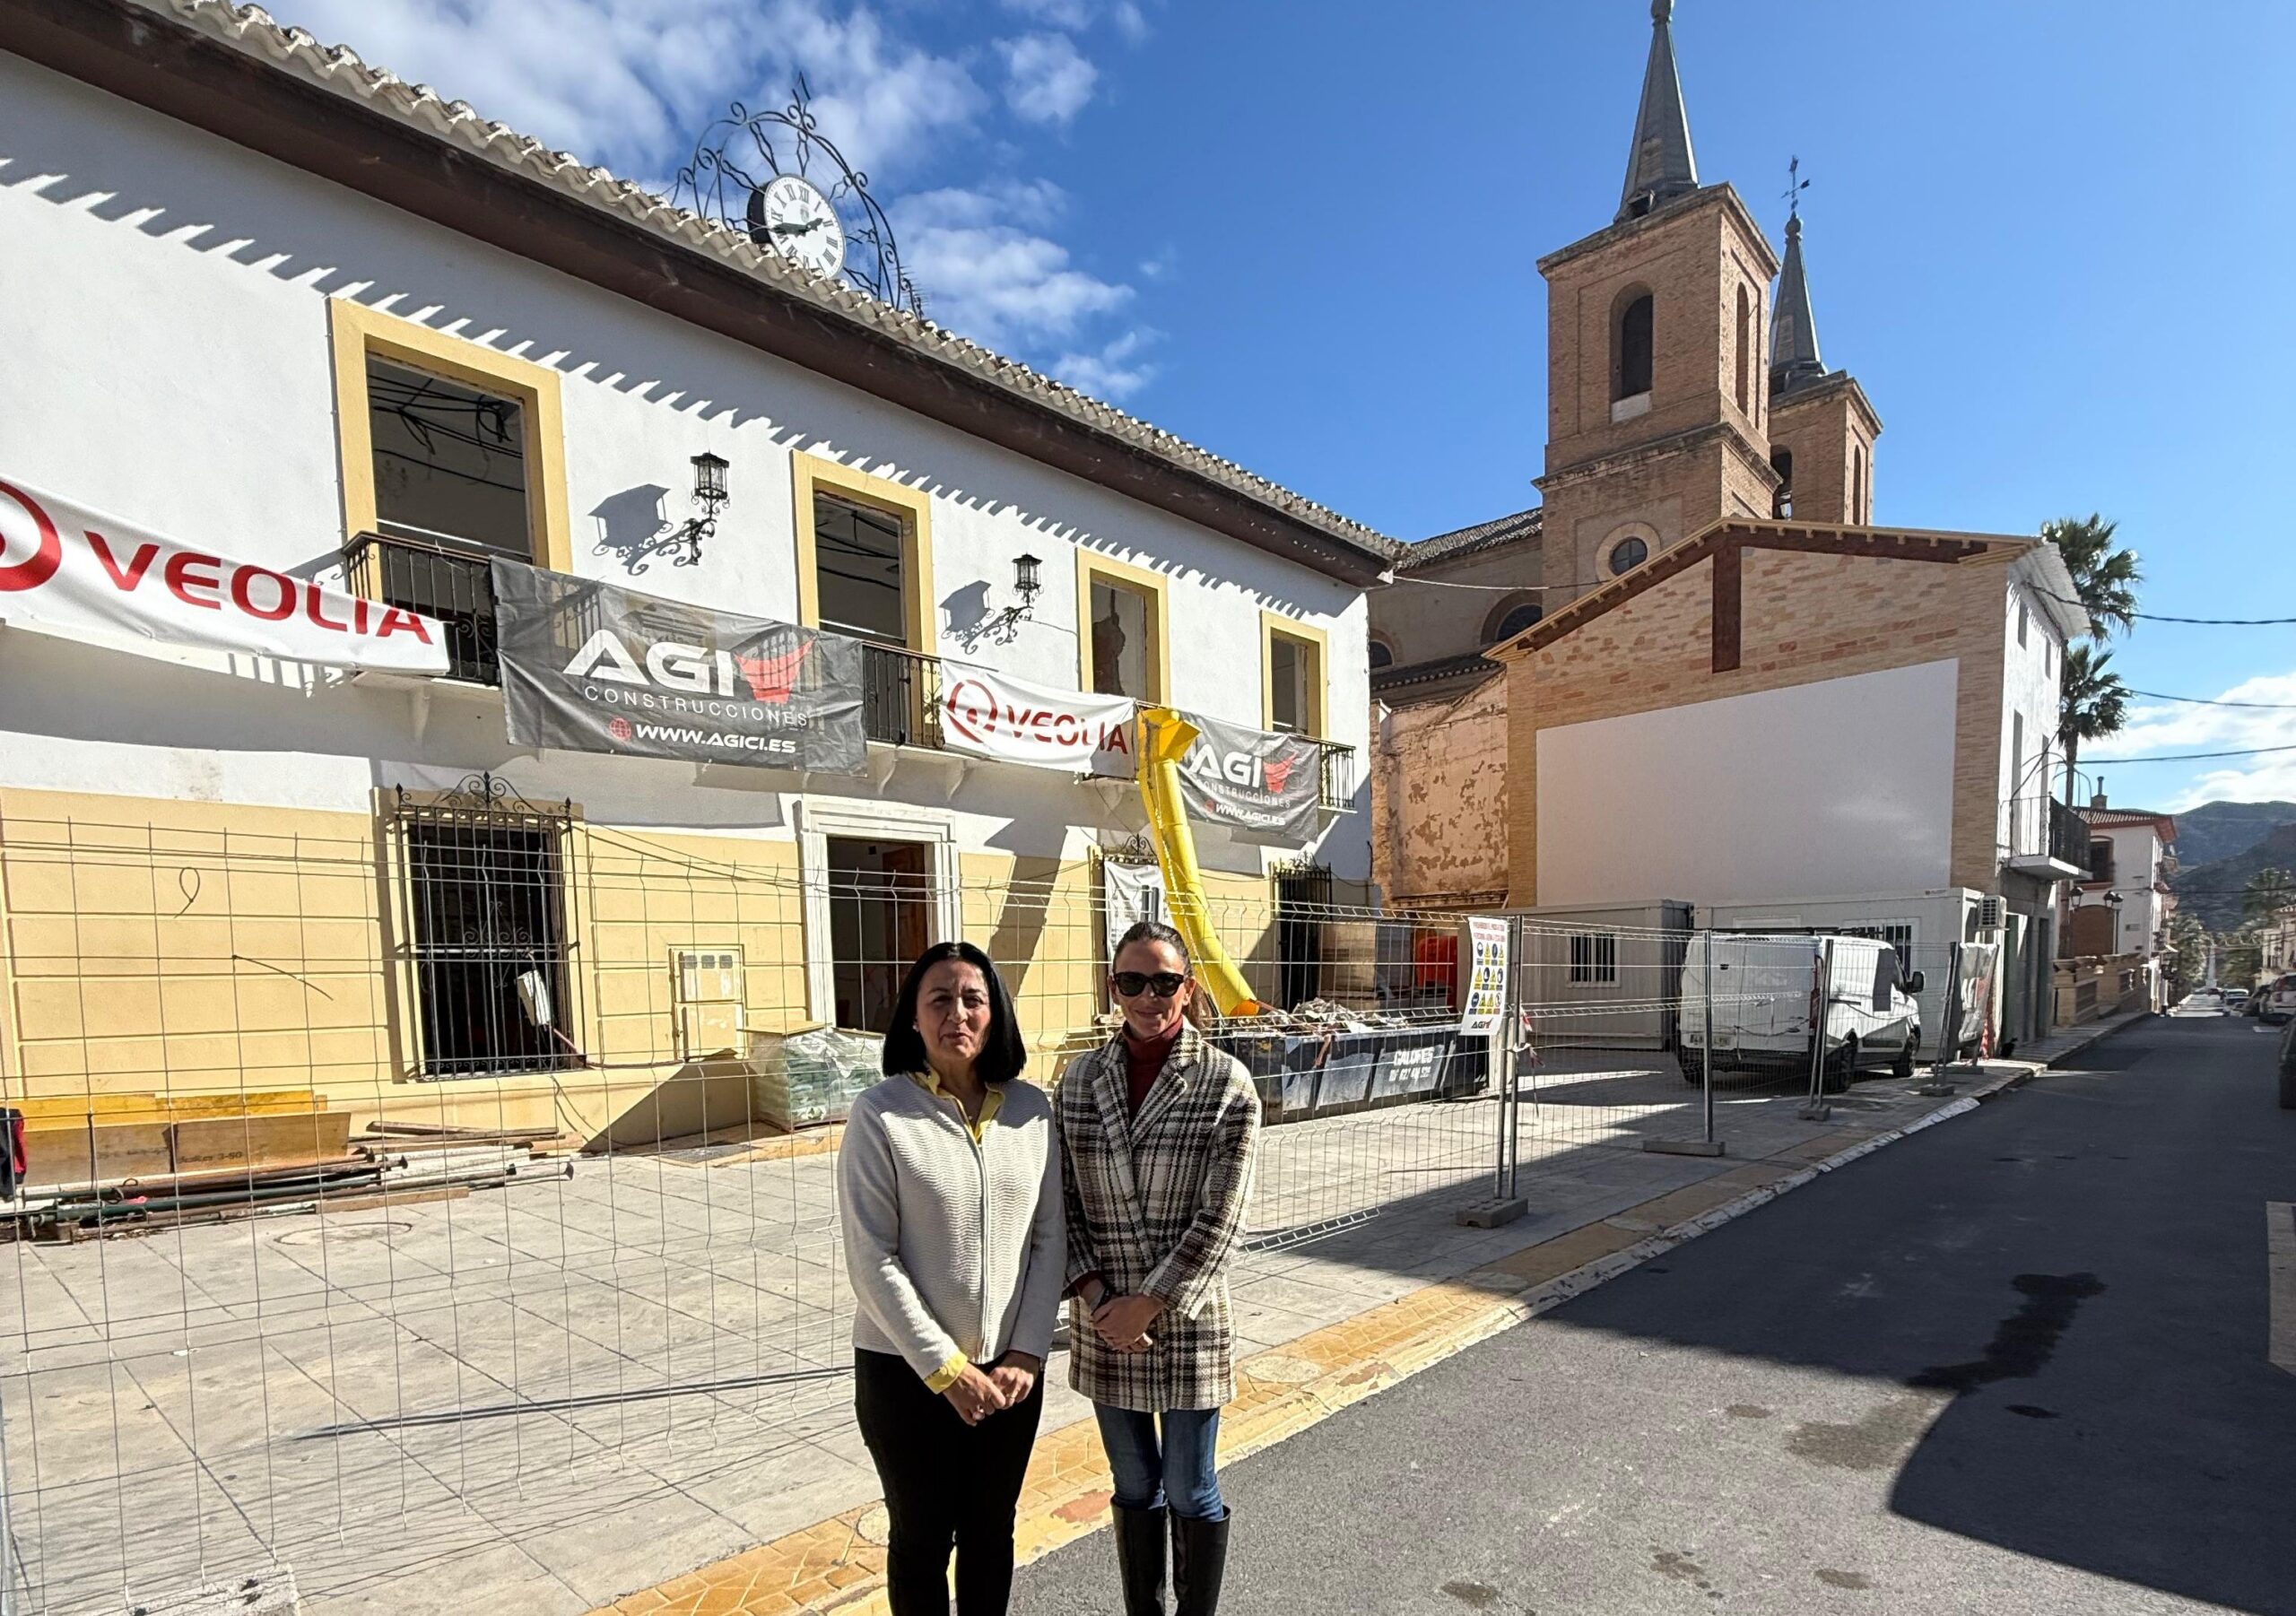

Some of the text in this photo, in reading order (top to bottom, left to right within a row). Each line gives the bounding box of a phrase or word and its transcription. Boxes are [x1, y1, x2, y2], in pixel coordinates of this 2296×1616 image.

[83, 530, 433, 645] VEOLIA
[585, 685, 808, 726] CONSTRUCCIONES
[635, 724, 797, 754] WWW.AGICI.ES
[1005, 704, 1129, 755] VEOLIA
